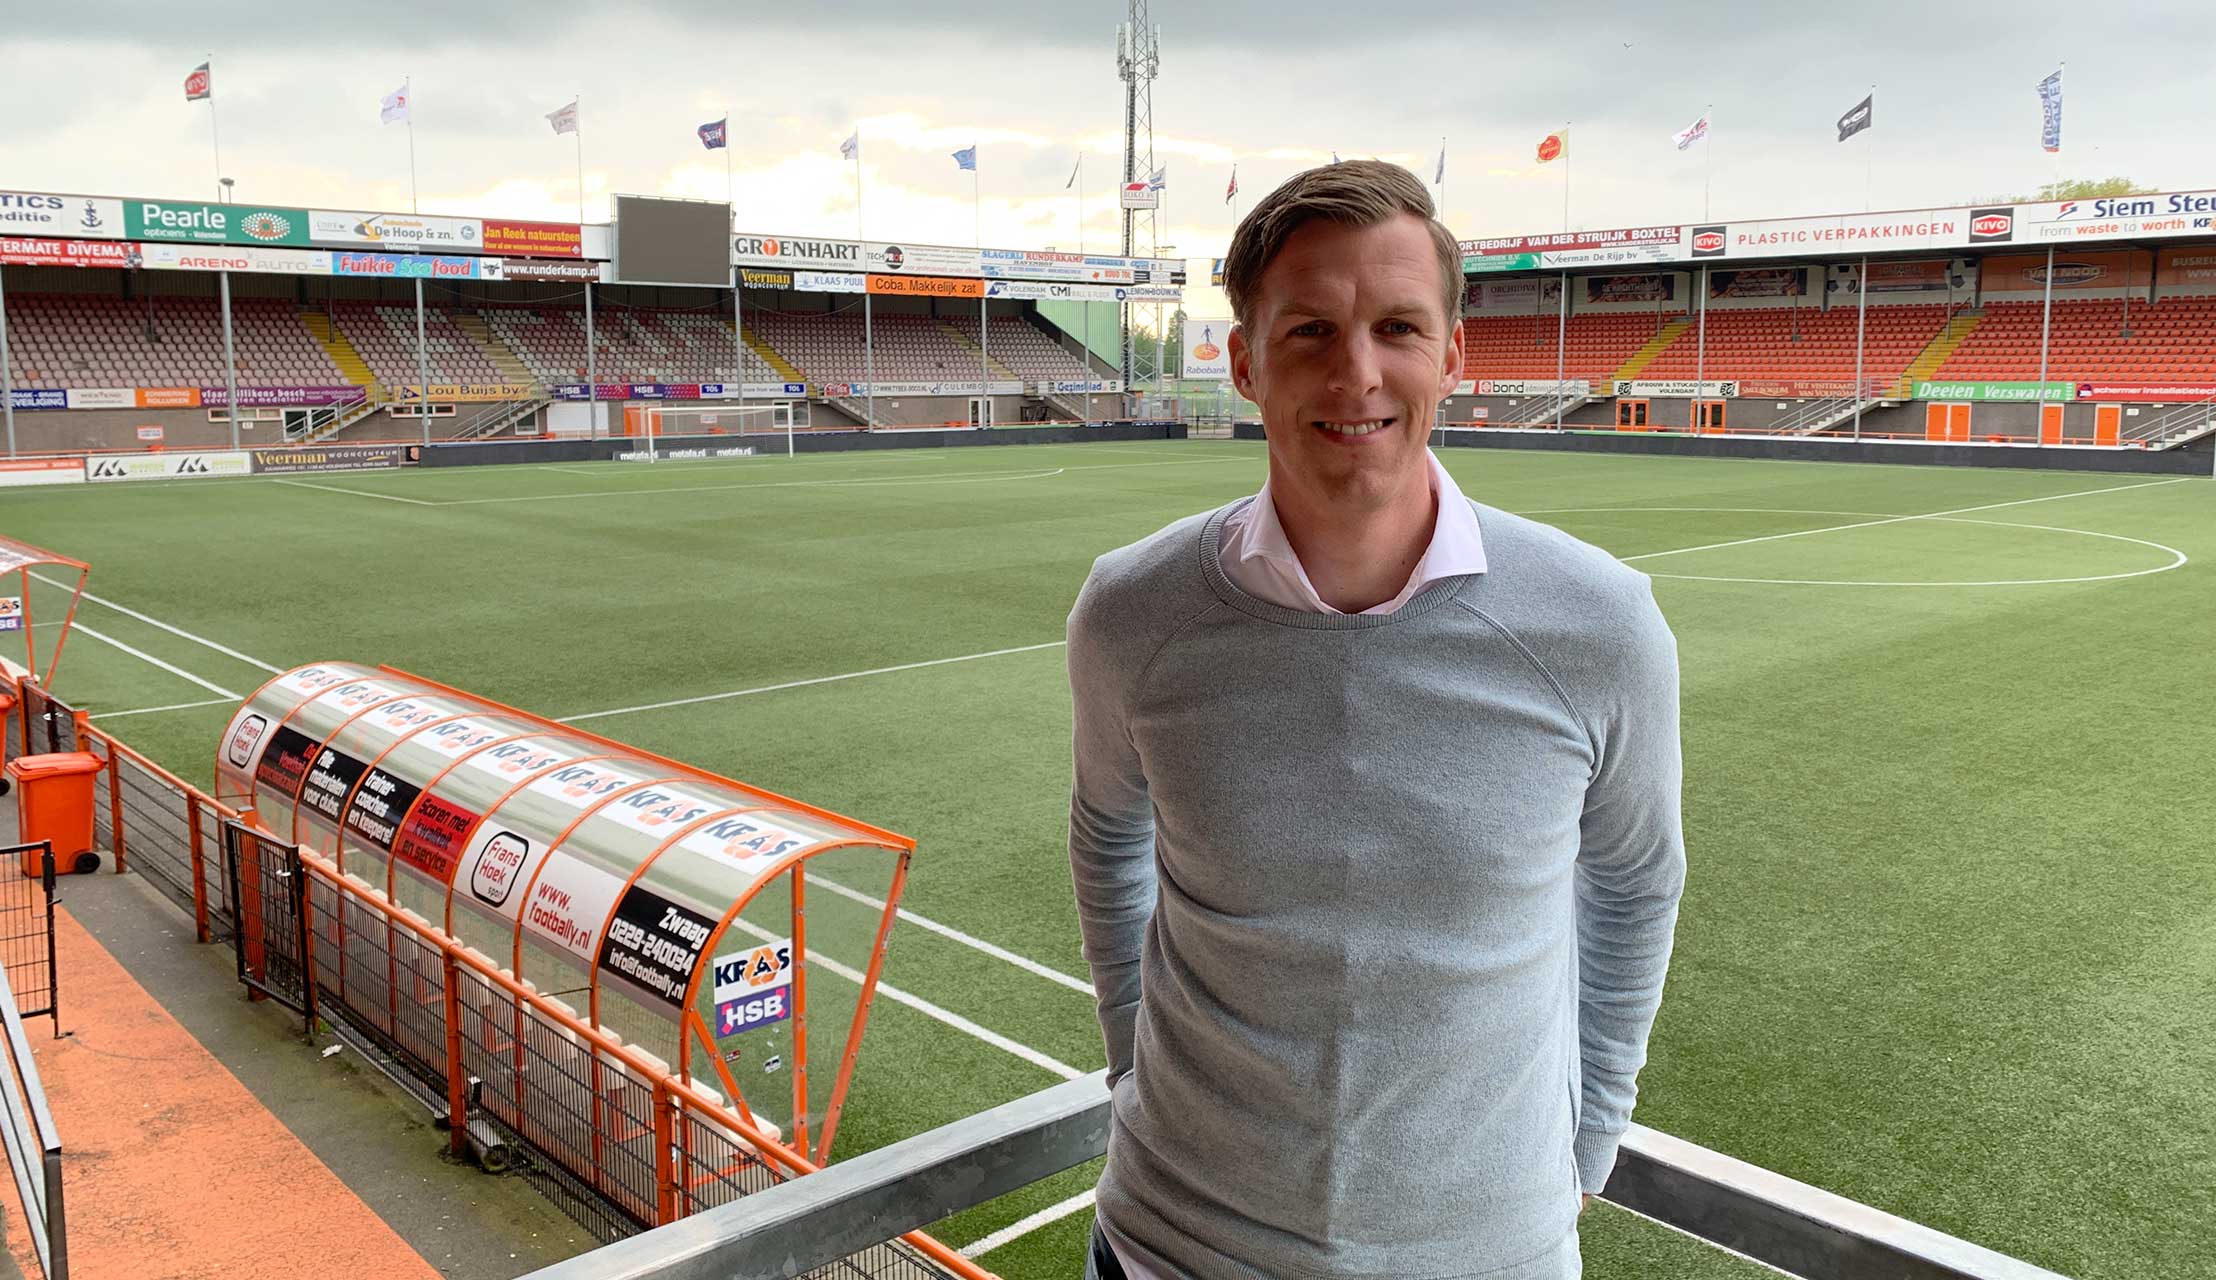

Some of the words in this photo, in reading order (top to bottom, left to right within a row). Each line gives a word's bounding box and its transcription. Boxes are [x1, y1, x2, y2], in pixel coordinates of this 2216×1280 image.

[143, 204, 226, 229] Pearle
[2094, 199, 2154, 218] Siem
[375, 225, 390, 236] De
[393, 226, 423, 240] Hoop
[426, 228, 434, 239] &
[437, 231, 454, 240] zn.
[484, 227, 500, 238] Jan
[503, 228, 526, 240] Reek
[528, 230, 580, 242] natuursteen
[1738, 231, 1806, 245] PLASTIC
[1813, 222, 1955, 242] VERPAKKINGEN
[1975, 220, 2007, 232] KIVO
[2040, 226, 2071, 237] from
[2076, 222, 2119, 235] waste
[2123, 222, 2137, 232] to
[2142, 218, 2186, 231] worth
[1527, 235, 1549, 247] VAN
[1552, 234, 1574, 245] DER
[1577, 230, 1627, 243] STRUIJK
[1632, 226, 1679, 240] BOXTEL
[1695, 236, 1722, 248] KIVO
[67, 243, 125, 257] DIVEMA
[735, 237, 859, 260] GROENHART
[982, 250, 1024, 260] SLAGERIJ
[1026, 252, 1084, 263] RUNDERKAMP
[1593, 253, 1605, 261] De
[1607, 252, 1625, 262] Rijp
[1627, 251, 1638, 260] bv
[178, 257, 248, 269] AREND
[255, 260, 308, 271] AUTO
[503, 264, 599, 278] www.runderkamp.nl
[741, 268, 790, 284] Veerman
[814, 276, 841, 286] KLAAS
[844, 277, 864, 286] PUUL
[876, 278, 906, 291] Coba.
[909, 280, 957, 295] Makkelijk
[961, 283, 976, 294] zat
[1185, 366, 1227, 375] Rabobank
[237, 389, 274, 398] illikens
[426, 386, 454, 395] Lou
[460, 385, 496, 396] Buijs
[502, 385, 519, 395] bv
[1058, 382, 1102, 391] Gezinslad
[1493, 381, 1524, 393] bond
[1918, 382, 1975, 398] Deelen
[255, 451, 327, 465] Veerman
[417, 798, 452, 827] Scoren
[447, 815, 473, 834] met
[348, 809, 360, 826] en
[358, 811, 395, 845] keepers!
[401, 840, 414, 856] en
[413, 844, 447, 874] service
[487, 841, 520, 867] Frans
[479, 858, 507, 886] Hoek
[538, 882, 572, 912] www.
[528, 901, 593, 951] footbally.nl
[658, 906, 710, 950] Zwaag
[608, 918, 696, 977] 0229-240034
[609, 948, 687, 1001] info@footbally.nl
[715, 947, 790, 988] KRAS
[726, 994, 784, 1027] HSB
